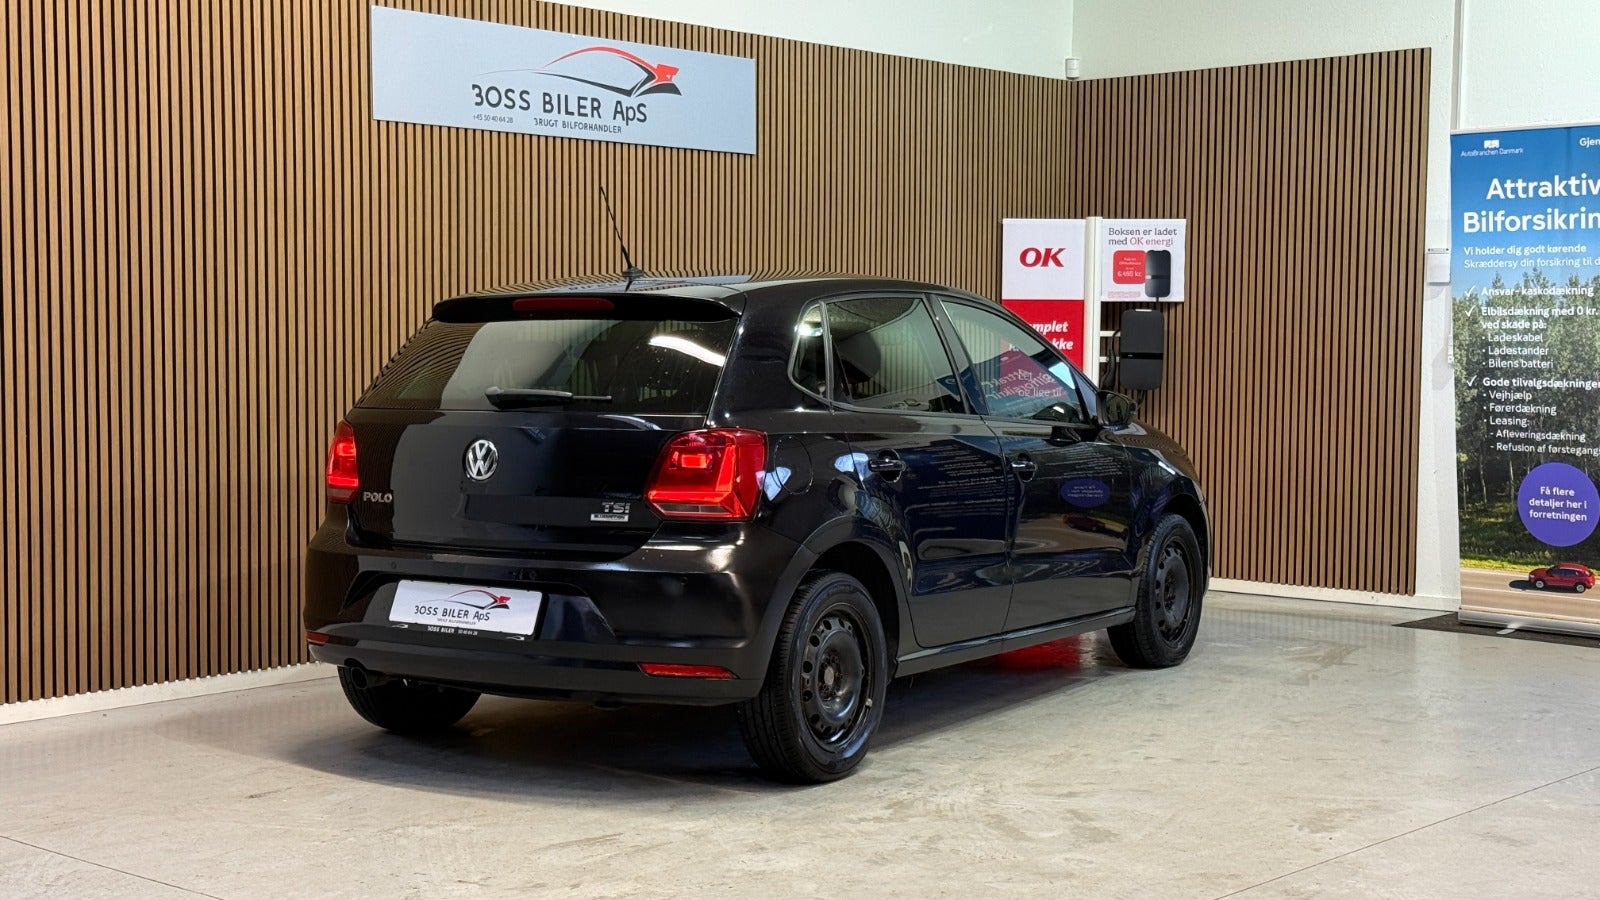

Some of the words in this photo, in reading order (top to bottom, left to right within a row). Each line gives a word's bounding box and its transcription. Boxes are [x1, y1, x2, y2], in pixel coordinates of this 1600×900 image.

[542, 92, 602, 119] BILER
[612, 100, 648, 126] ApS
[483, 114, 491, 122] 50
[562, 120, 622, 134] BILFORHANDLER
[1108, 227, 1141, 236] Boksen
[1154, 227, 1177, 236] ladet
[1108, 237, 1128, 246] med
[1129, 237, 1144, 246] OK
[1145, 238, 1174, 248] energi
[1464, 246, 1474, 256] Vi
[1475, 245, 1505, 255] holder
[1506, 245, 1522, 257] dig
[1523, 244, 1546, 256] godt
[1547, 243, 1587, 253] kørende
[1019, 247, 1066, 268] OK
[1464, 258, 1518, 270] Skræddersy
[1520, 257, 1535, 267] din
[1536, 257, 1580, 268] forsikring
[1582, 256, 1592, 266] til
[1521, 286, 1594, 298] kaskodækning
[1481, 306, 1550, 318] Elbilsdækning
[1551, 306, 1575, 316] med
[1576, 306, 1584, 316] 0
[1029, 320, 1069, 335] mplet
[1482, 320, 1500, 329] ved
[1501, 320, 1530, 329] skade
[1532, 319, 1547, 331] på:
[1488, 333, 1543, 342] Ladeskabel
[1050, 338, 1074, 350] kke
[1488, 346, 1549, 355] Ladestander
[1488, 359, 1519, 369] Bilens
[1521, 359, 1554, 369] batteri
[1482, 378, 1510, 387] Gode
[1489, 390, 1533, 402] Vejhjælp
[1489, 403, 1557, 416] Førerdækning
[1496, 429, 1586, 443] Afleveringsdækning
[1496, 442, 1536, 453] Refusion
[1537, 444, 1547, 453] af
[362, 491, 393, 503] POLO
[1540, 486, 1551, 495] Få
[1552, 487, 1575, 497] flere
[1529, 498, 1565, 511] detaljer
[1566, 500, 1581, 509] her
[1529, 511, 1588, 523] forretningen
[442, 607, 469, 620] BILER
[472, 610, 491, 622] ApS
